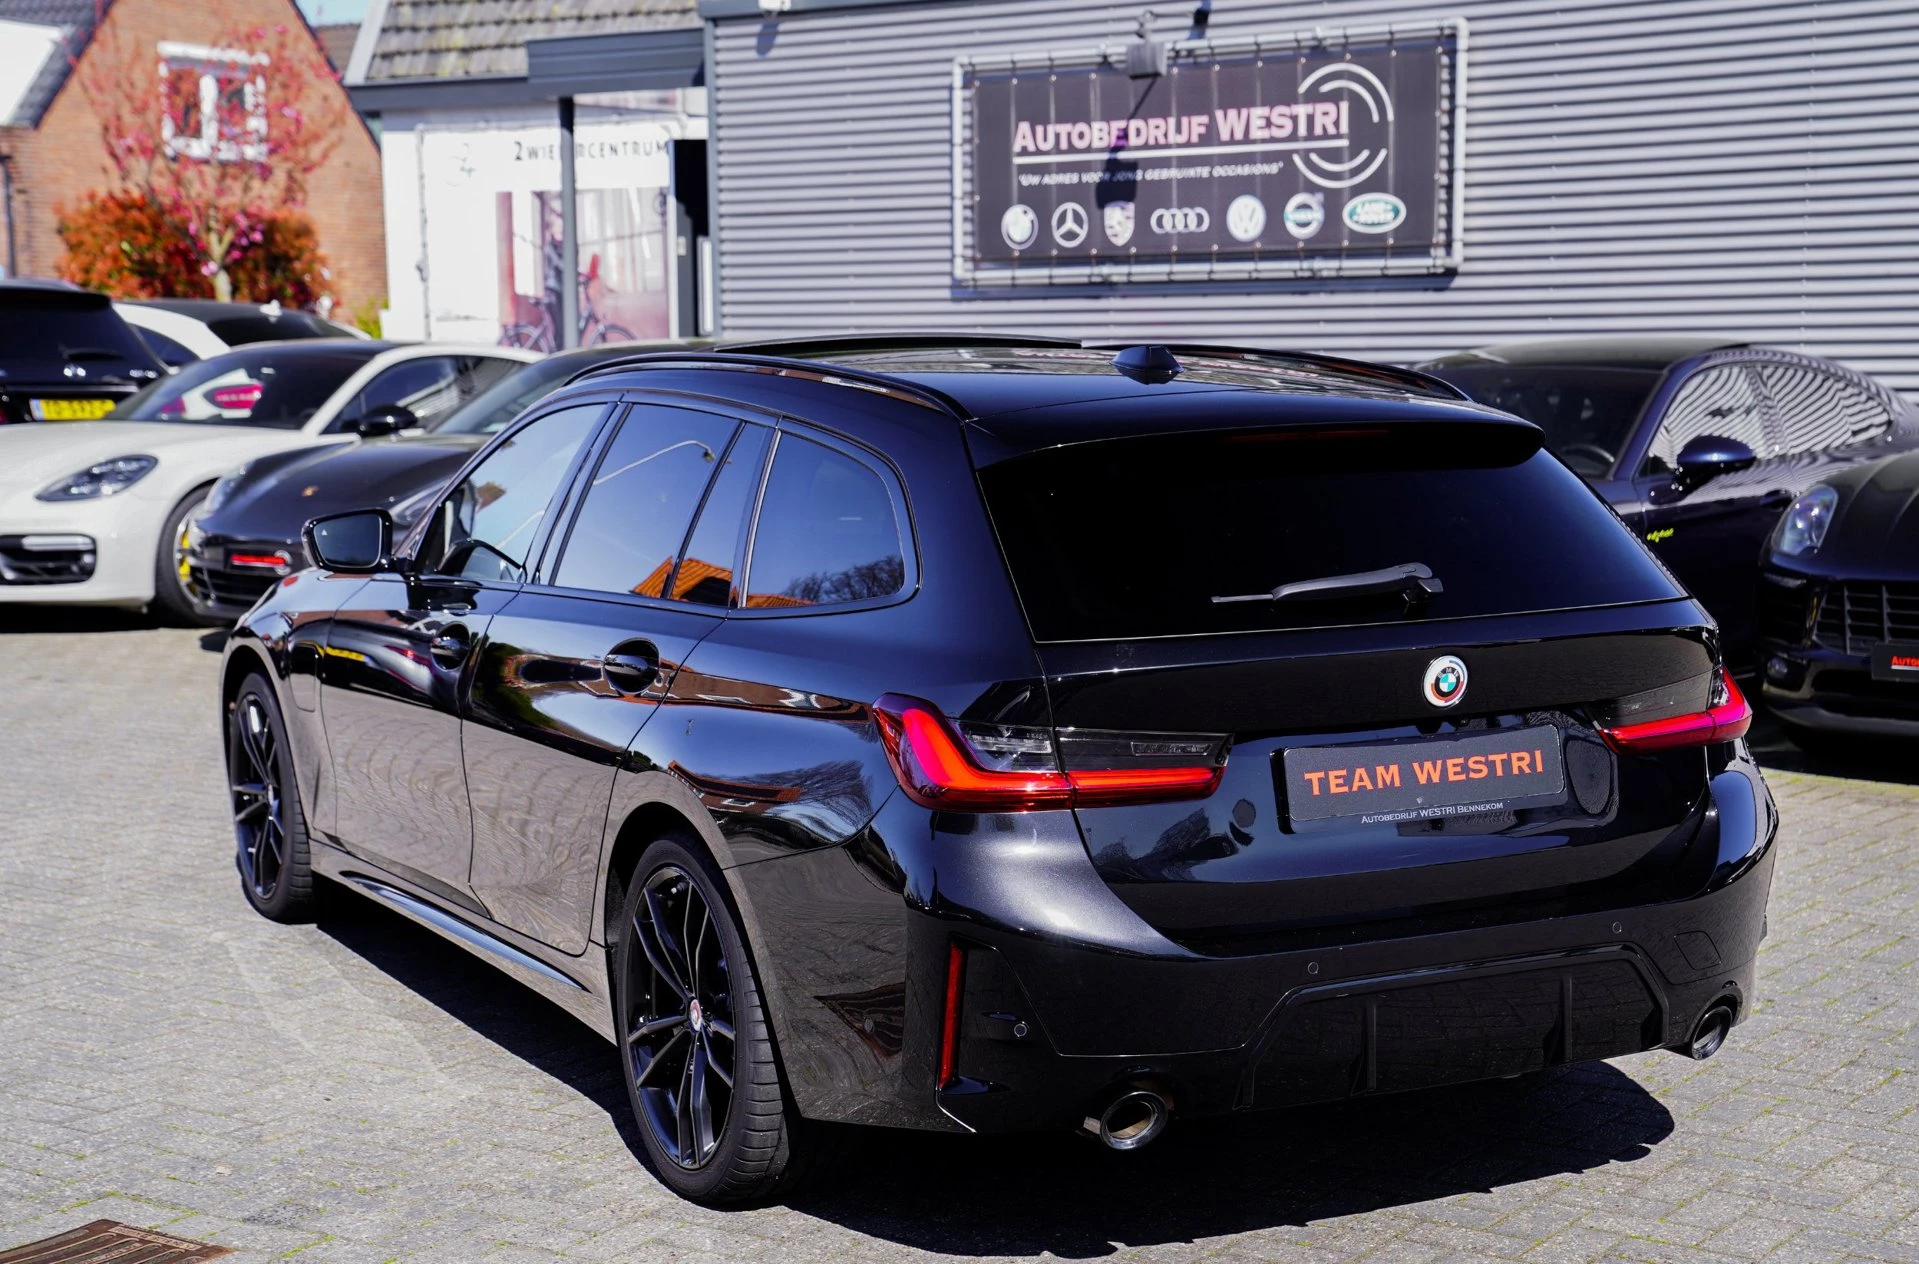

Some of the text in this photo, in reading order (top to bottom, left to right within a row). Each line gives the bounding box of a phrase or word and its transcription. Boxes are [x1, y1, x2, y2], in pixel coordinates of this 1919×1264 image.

[1013, 101, 1350, 153] AUTOBEDRIJF WESTRI
[514, 139, 669, 161] 2WIERCENTRUM
[1891, 655, 1919, 667] AUTO
[1437, 667, 1461, 679] BMW
[1304, 749, 1544, 796] TEAM WESTRI
[1361, 802, 1504, 824] AUTOBEDRIJF WESTRI BENNEKOM
